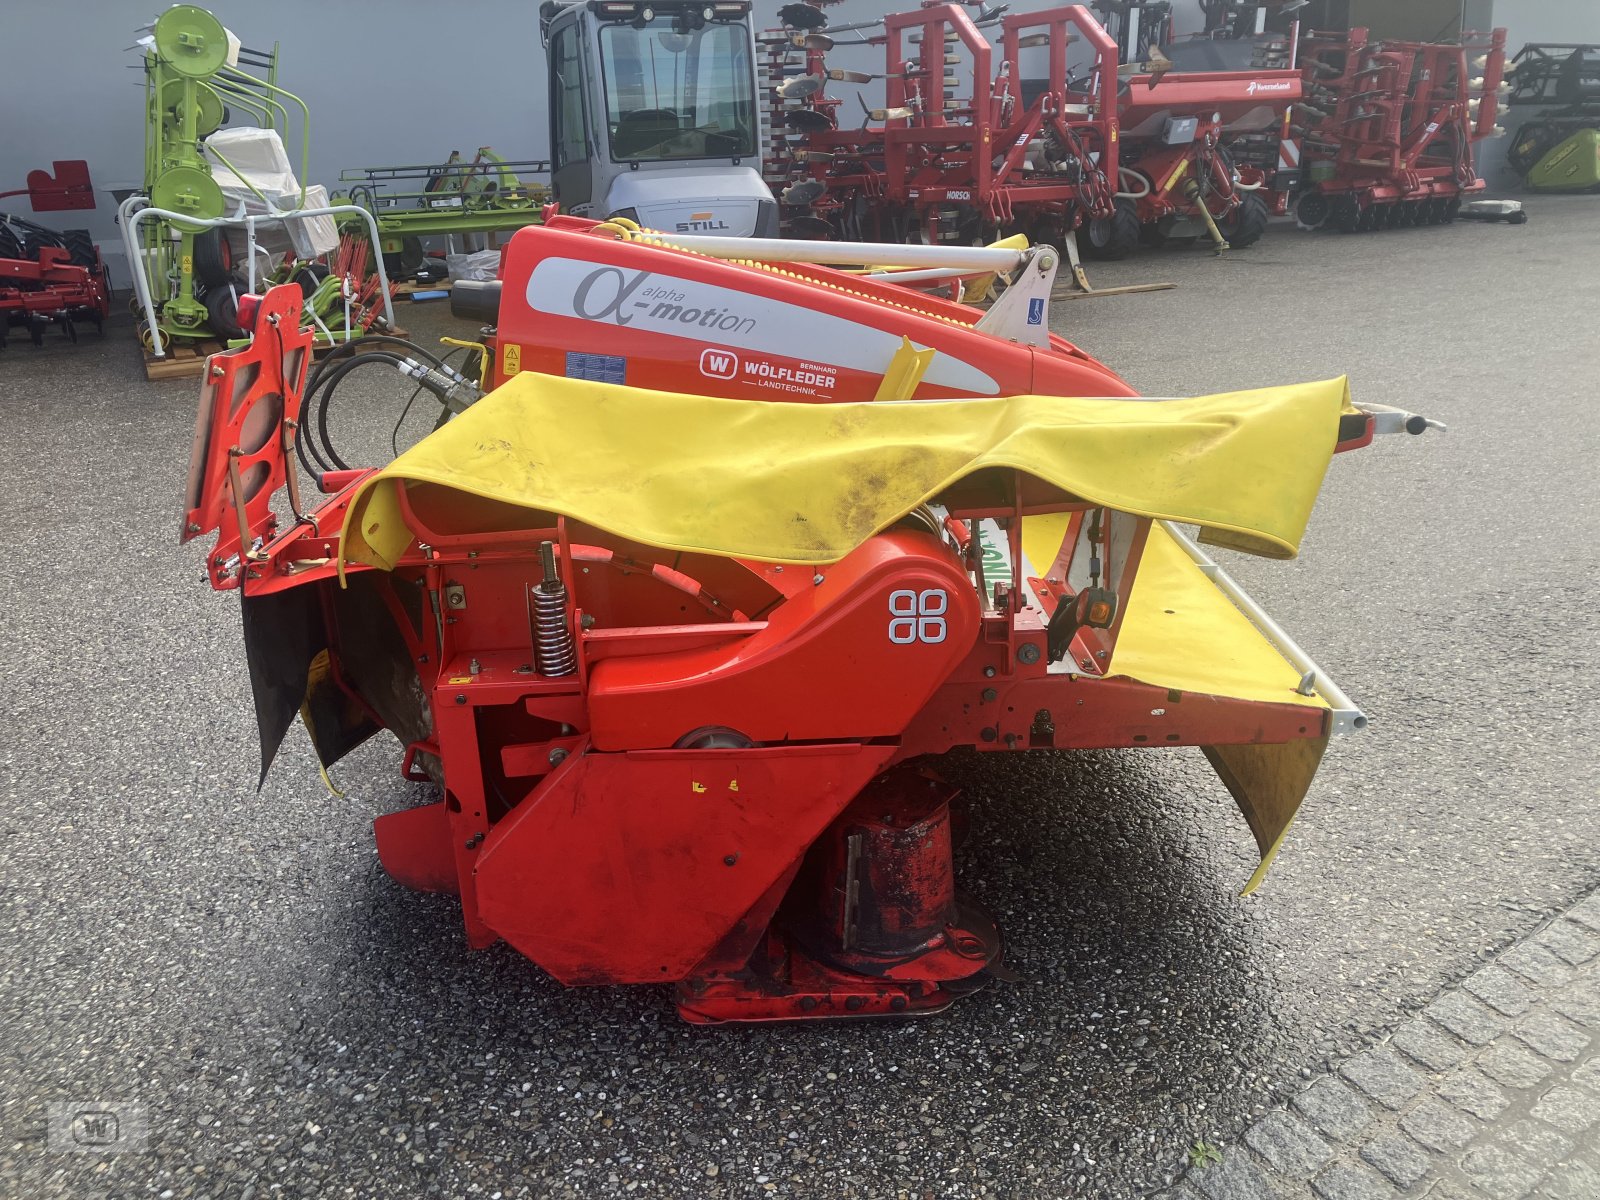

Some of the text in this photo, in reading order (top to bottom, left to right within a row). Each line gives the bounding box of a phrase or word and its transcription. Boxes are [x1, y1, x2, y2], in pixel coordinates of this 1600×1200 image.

[946, 190, 971, 200] HORSCH
[676, 220, 730, 232] STILL
[642, 286, 686, 302] alpha
[709, 355, 730, 373] W
[800, 363, 837, 375] BERNHARD
[744, 361, 836, 388] WÖLFLEDER
[758, 379, 816, 396] LANDTECHNIK
